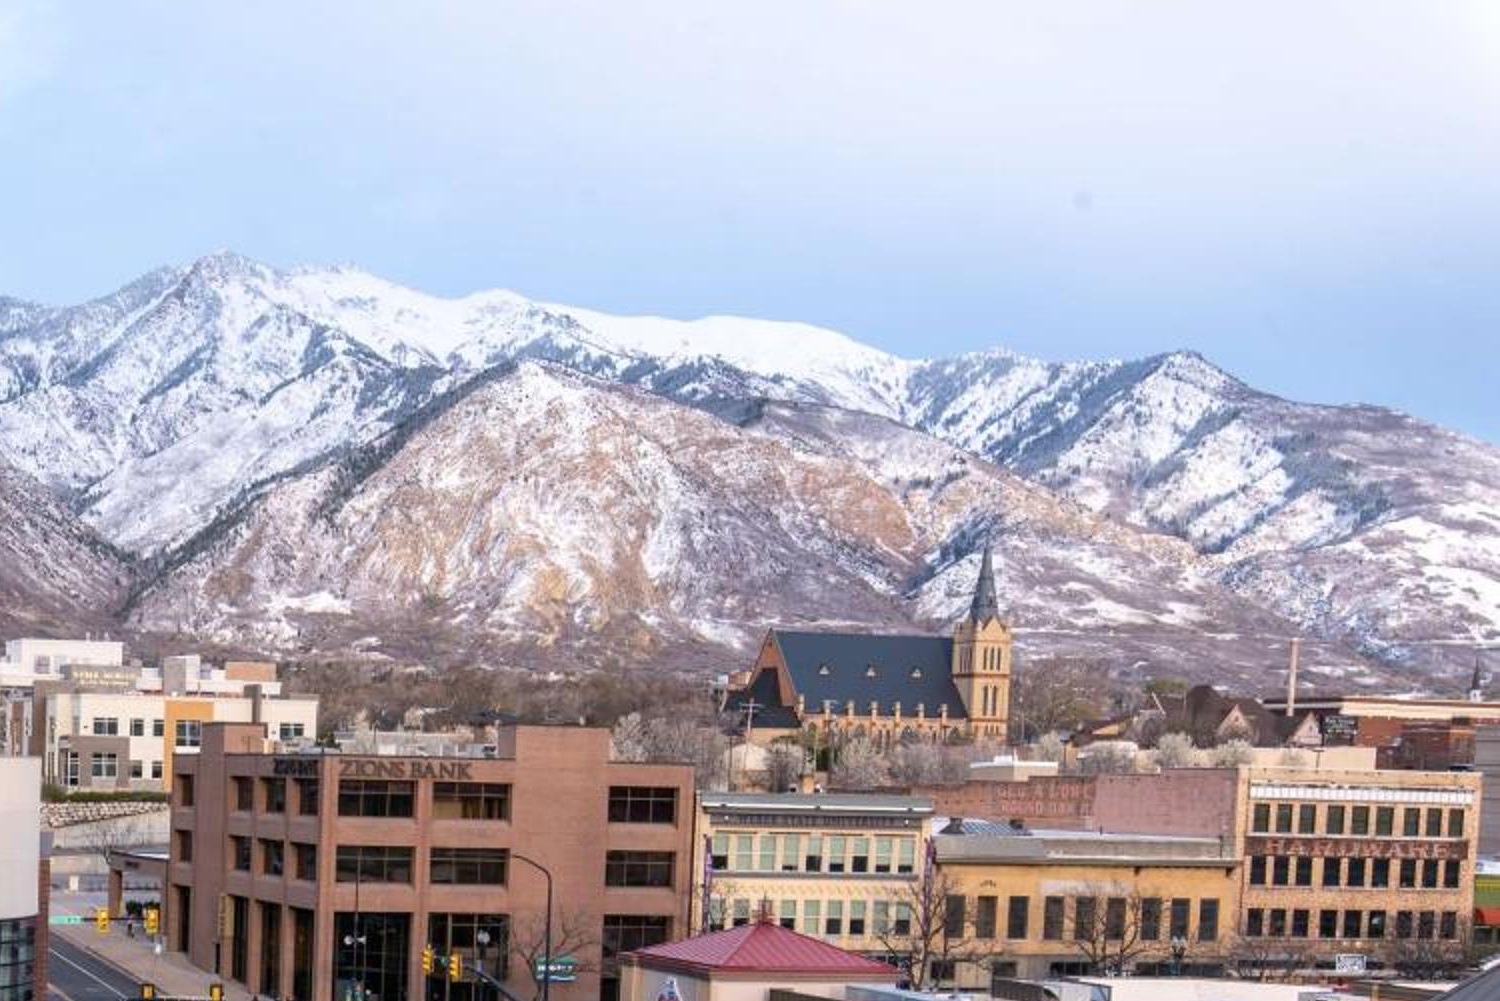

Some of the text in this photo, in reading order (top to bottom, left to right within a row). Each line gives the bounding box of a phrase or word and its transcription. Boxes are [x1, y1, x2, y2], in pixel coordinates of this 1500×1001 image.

[339, 759, 405, 777] ZIONS
[410, 761, 473, 780] BANK
[1266, 840, 1449, 858] HARDWARE
